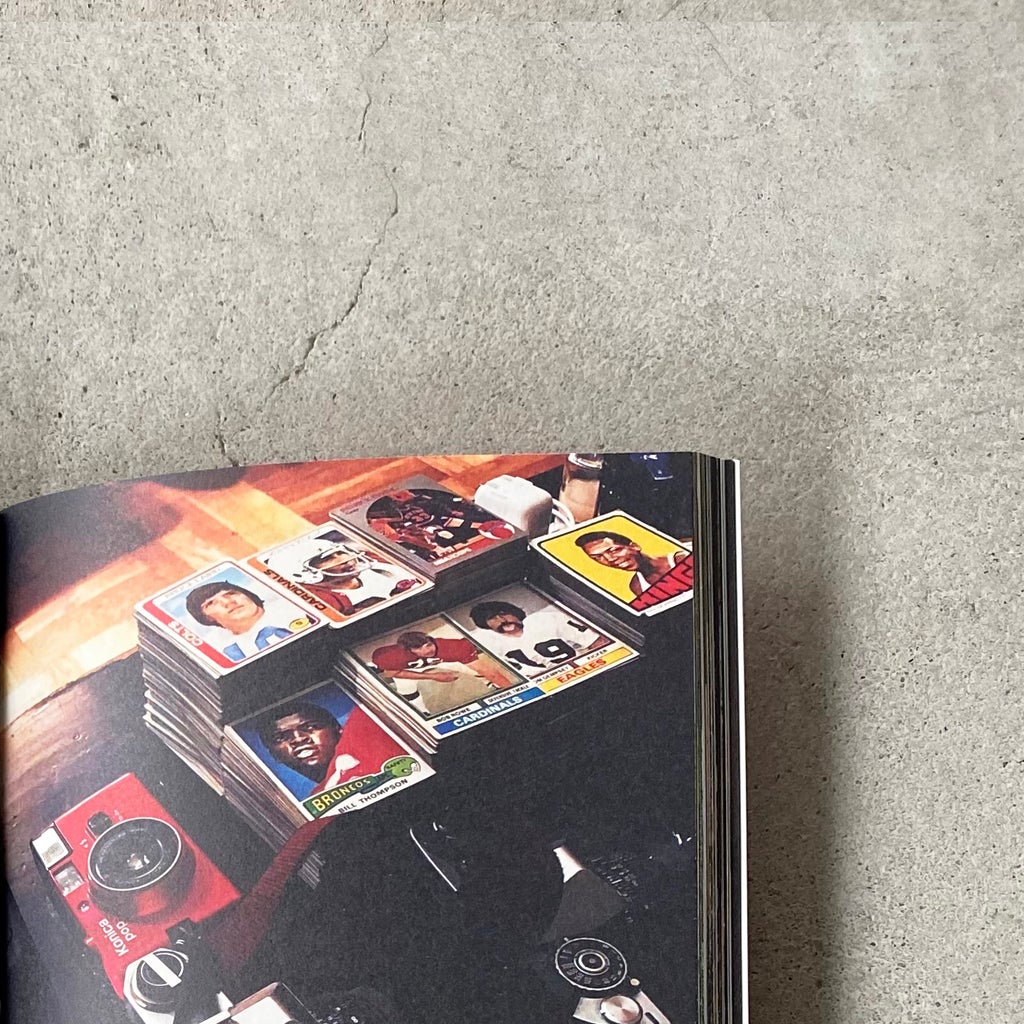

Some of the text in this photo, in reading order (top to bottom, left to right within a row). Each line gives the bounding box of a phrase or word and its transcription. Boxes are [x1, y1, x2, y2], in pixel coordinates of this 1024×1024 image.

[264, 569, 327, 611] CARDINALS
[629, 552, 693, 612] KING
[168, 621, 203, 646] COLTS
[557, 658, 606, 684] EAGLES
[452, 696, 523, 727] CARDINALS
[311, 777, 372, 812] BRONCOS
[337, 778, 408, 814] BILL THOMPSON
[98, 918, 130, 957] Konica
[115, 920, 137, 942] pop
